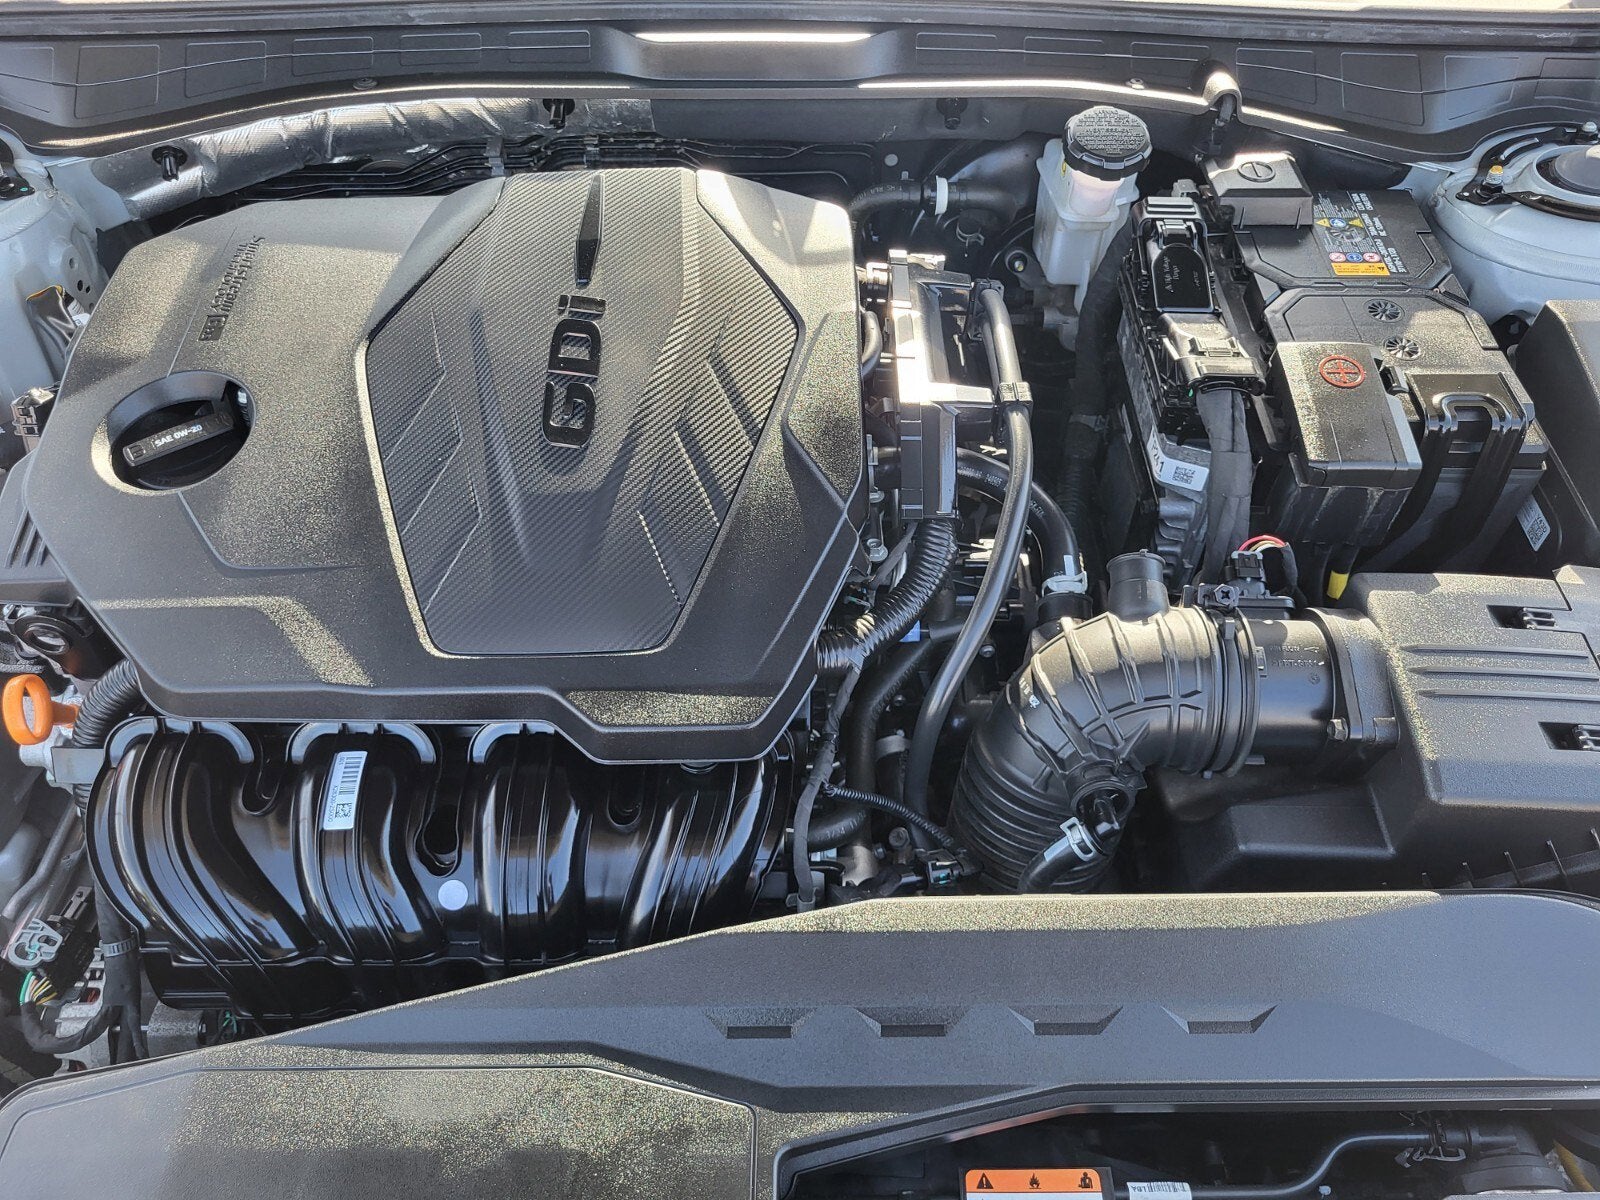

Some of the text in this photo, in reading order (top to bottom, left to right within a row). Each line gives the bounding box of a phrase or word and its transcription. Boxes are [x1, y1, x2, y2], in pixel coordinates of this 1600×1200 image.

[220, 235, 265, 313] Smartstream
[155, 424, 203, 447] SAE 0W-20
